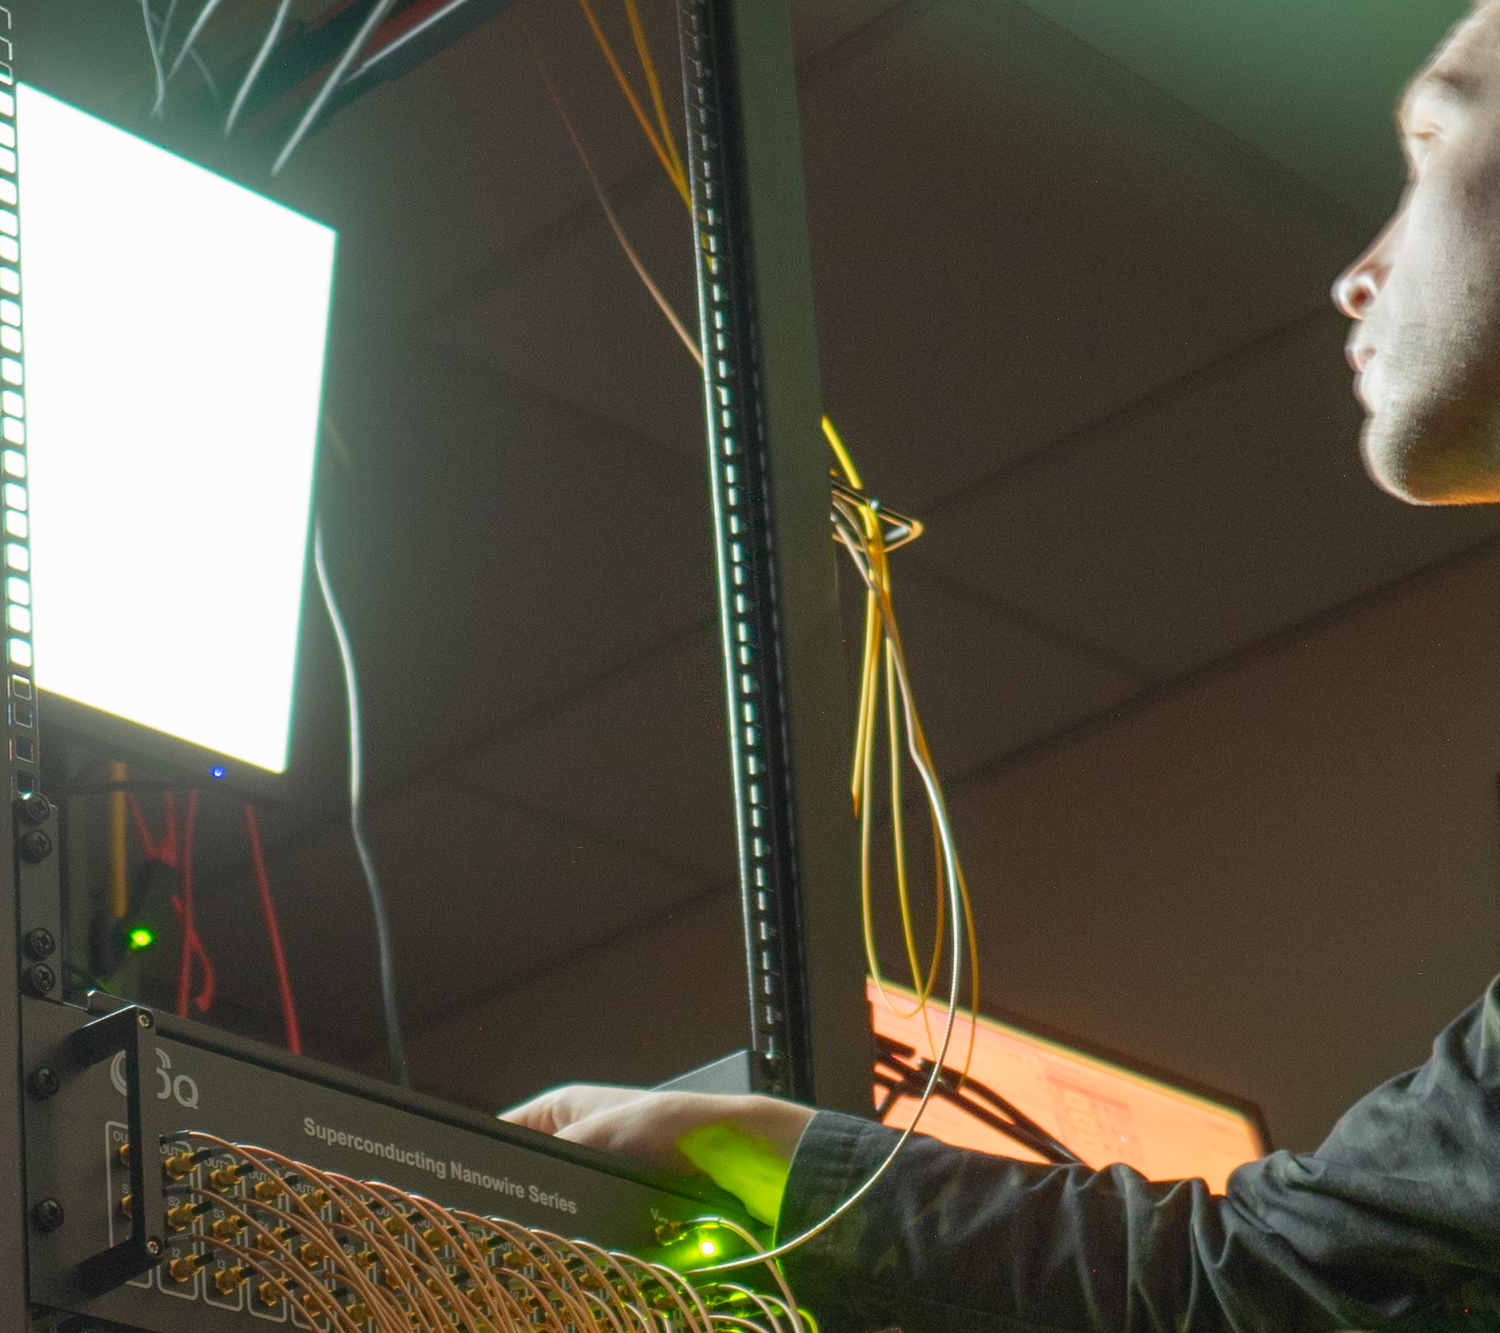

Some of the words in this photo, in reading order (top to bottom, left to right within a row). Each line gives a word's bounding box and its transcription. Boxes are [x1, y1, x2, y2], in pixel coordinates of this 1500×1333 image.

[303, 1117, 446, 1180] Superconducting
[450, 1160, 525, 1199] Nanowire
[528, 1185, 578, 1215] Series
